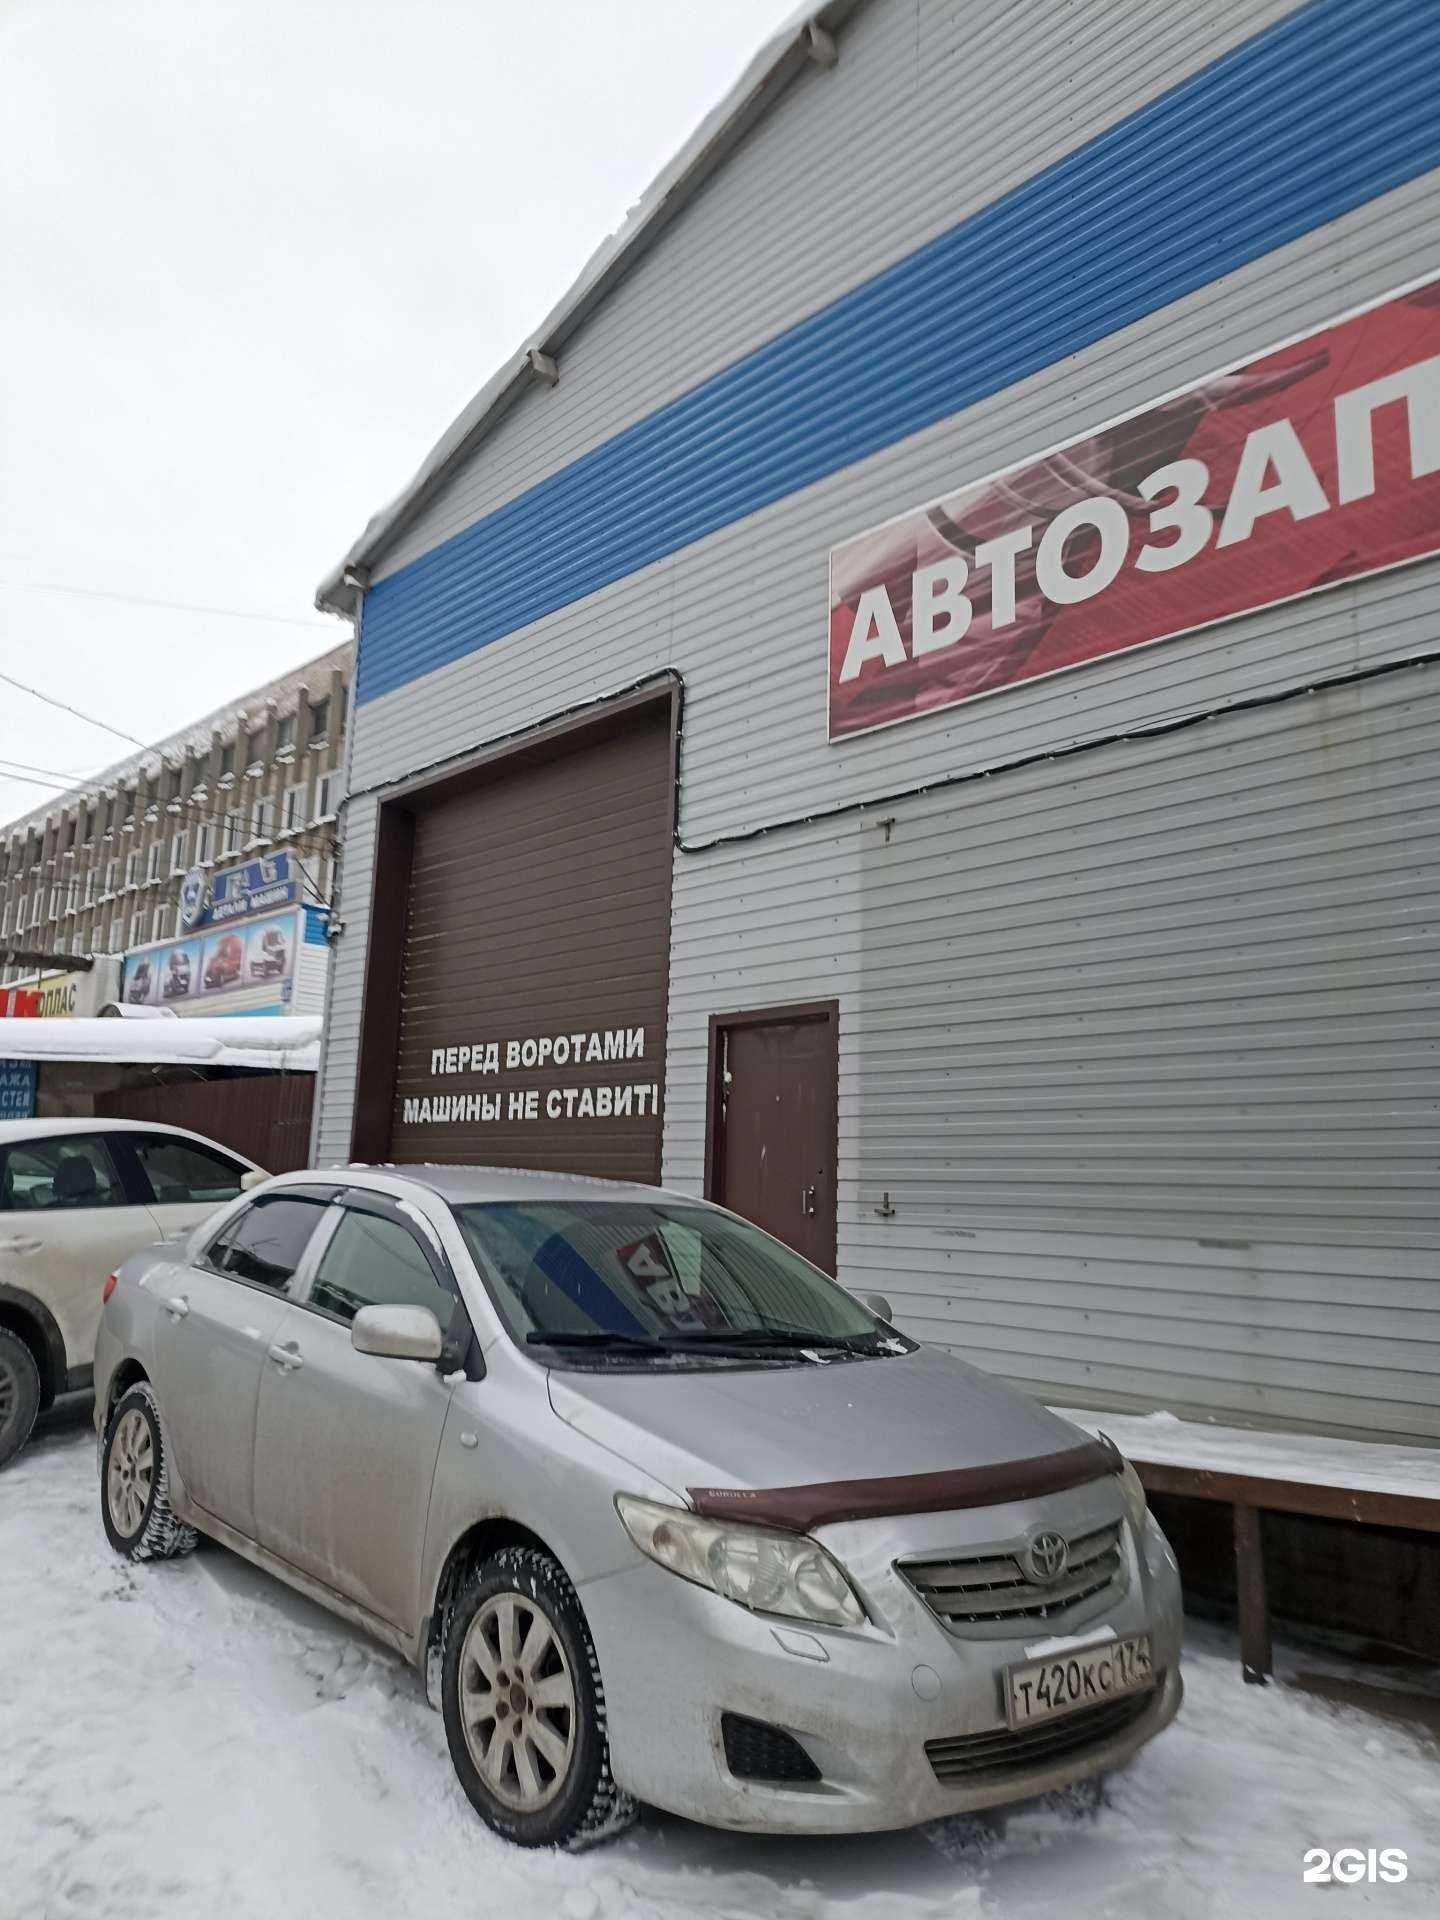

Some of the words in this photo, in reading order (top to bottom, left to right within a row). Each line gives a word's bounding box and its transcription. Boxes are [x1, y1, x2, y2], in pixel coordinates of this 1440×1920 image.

[430, 1042, 499, 1075] ПЕРЕД
[506, 1027, 645, 1069] ВОРОТАМИ
[403, 1092, 501, 1124] МАШИНЫ
[508, 1090, 539, 1121] НЕ
